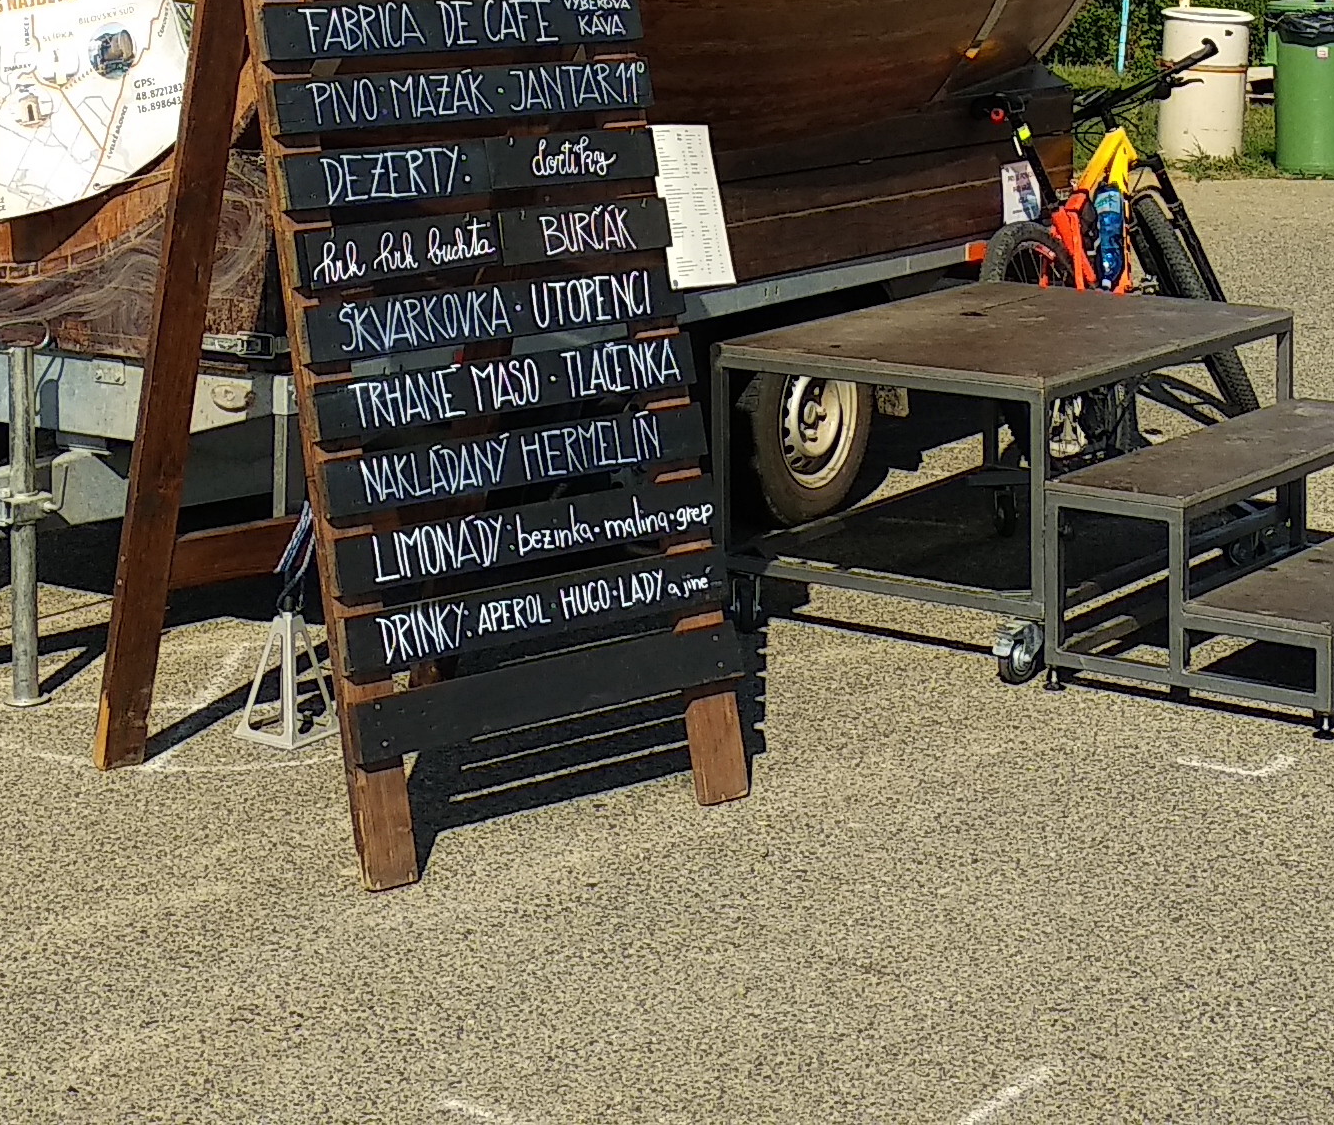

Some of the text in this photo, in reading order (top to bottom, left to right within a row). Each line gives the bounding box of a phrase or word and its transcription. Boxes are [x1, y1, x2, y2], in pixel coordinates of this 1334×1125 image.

[297, 0, 427, 54] FABRICA
[435, 1, 477, 47] DE
[577, 12, 627, 36] KÁVA
[133, 77, 156, 90] GPS:
[389, 70, 494, 119] MAZÁK
[320, 146, 472, 206] DEZERTY:
[539, 204, 638, 256] BURČÁK
[337, 271, 652, 352] ŠKVARKOVKA UTOPENCI
[348, 338, 683, 429] TRHANÉ MASO TLAČENKA
[359, 410, 663, 505] NAKLÁDANÝ HERMELÍN
[515, 505, 593, 557] bezinka
[603, 495, 669, 539] malina
[674, 502, 714, 532] grep
[375, 601, 473, 666] DRINKY:
[477, 598, 553, 637] APEROL
[560, 582, 612, 620] HUGO
[618, 569, 665, 608] LADY
[681, 565, 713, 600] jiné
